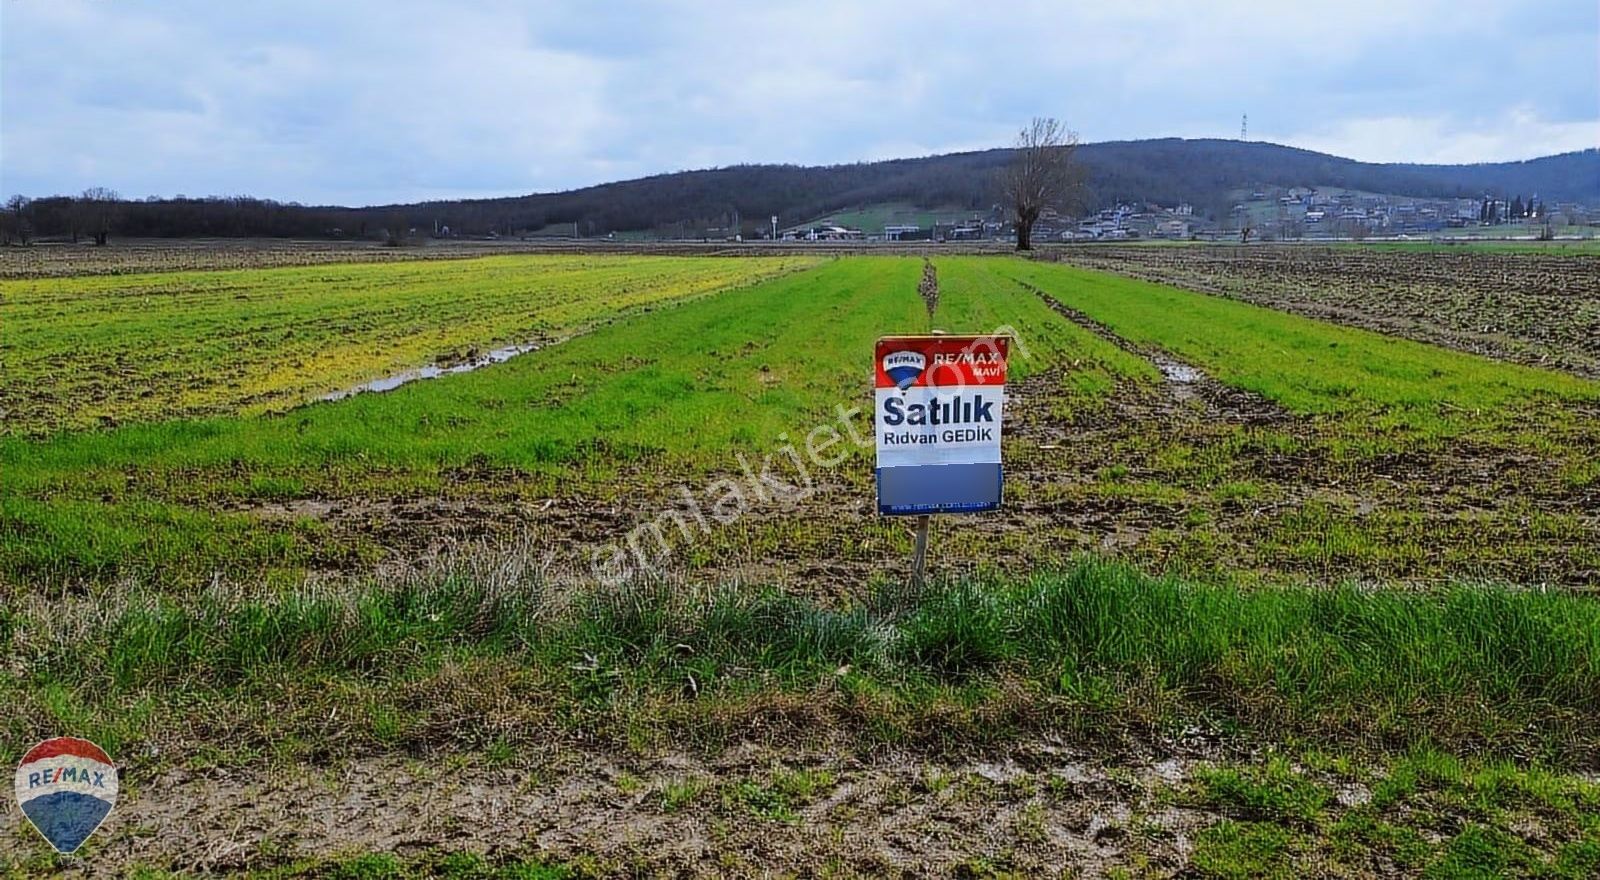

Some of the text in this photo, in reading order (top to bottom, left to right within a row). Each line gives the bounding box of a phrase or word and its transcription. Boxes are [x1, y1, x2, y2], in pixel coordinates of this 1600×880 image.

[888, 354, 922, 364] RE/MAX
[934, 353, 998, 365] RE/MAX
[884, 396, 993, 425] Satılık
[884, 427, 992, 444] Rıdvan GEDİK
